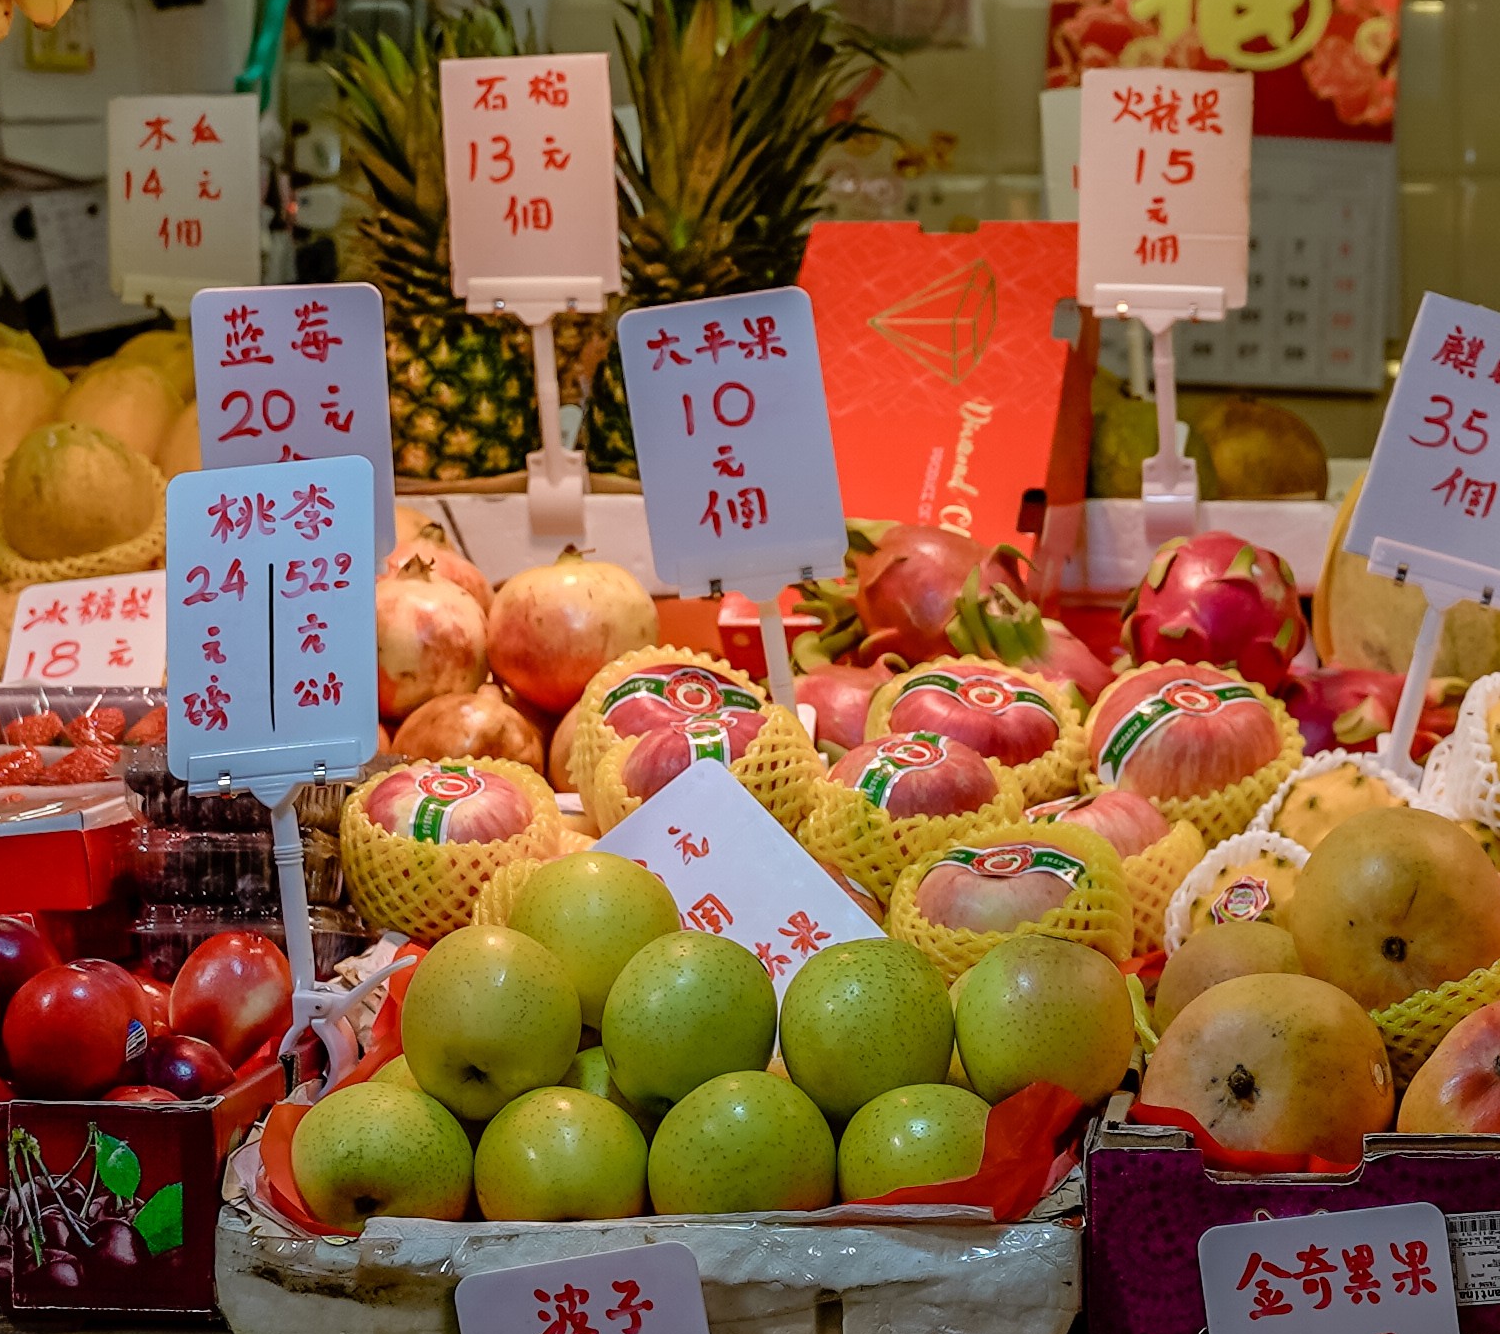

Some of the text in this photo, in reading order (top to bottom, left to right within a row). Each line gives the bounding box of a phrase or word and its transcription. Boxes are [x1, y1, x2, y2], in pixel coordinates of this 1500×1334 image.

[474, 70, 569, 110] 石榴
[468, 134, 571, 184] 13 元
[1135, 148, 1195, 186] 15
[124, 168, 164, 200] 14
[218, 384, 354, 442] 20 元
[682, 381, 756, 436] 10
[1411, 394, 1489, 456] 35
[712, 445, 745, 478] 元
[206, 483, 335, 542] 桃李
[700, 487, 768, 536] 個
[1433, 467, 1499, 518] 個
[182, 558, 248, 607] 24
[23, 638, 133, 679] 18 元
